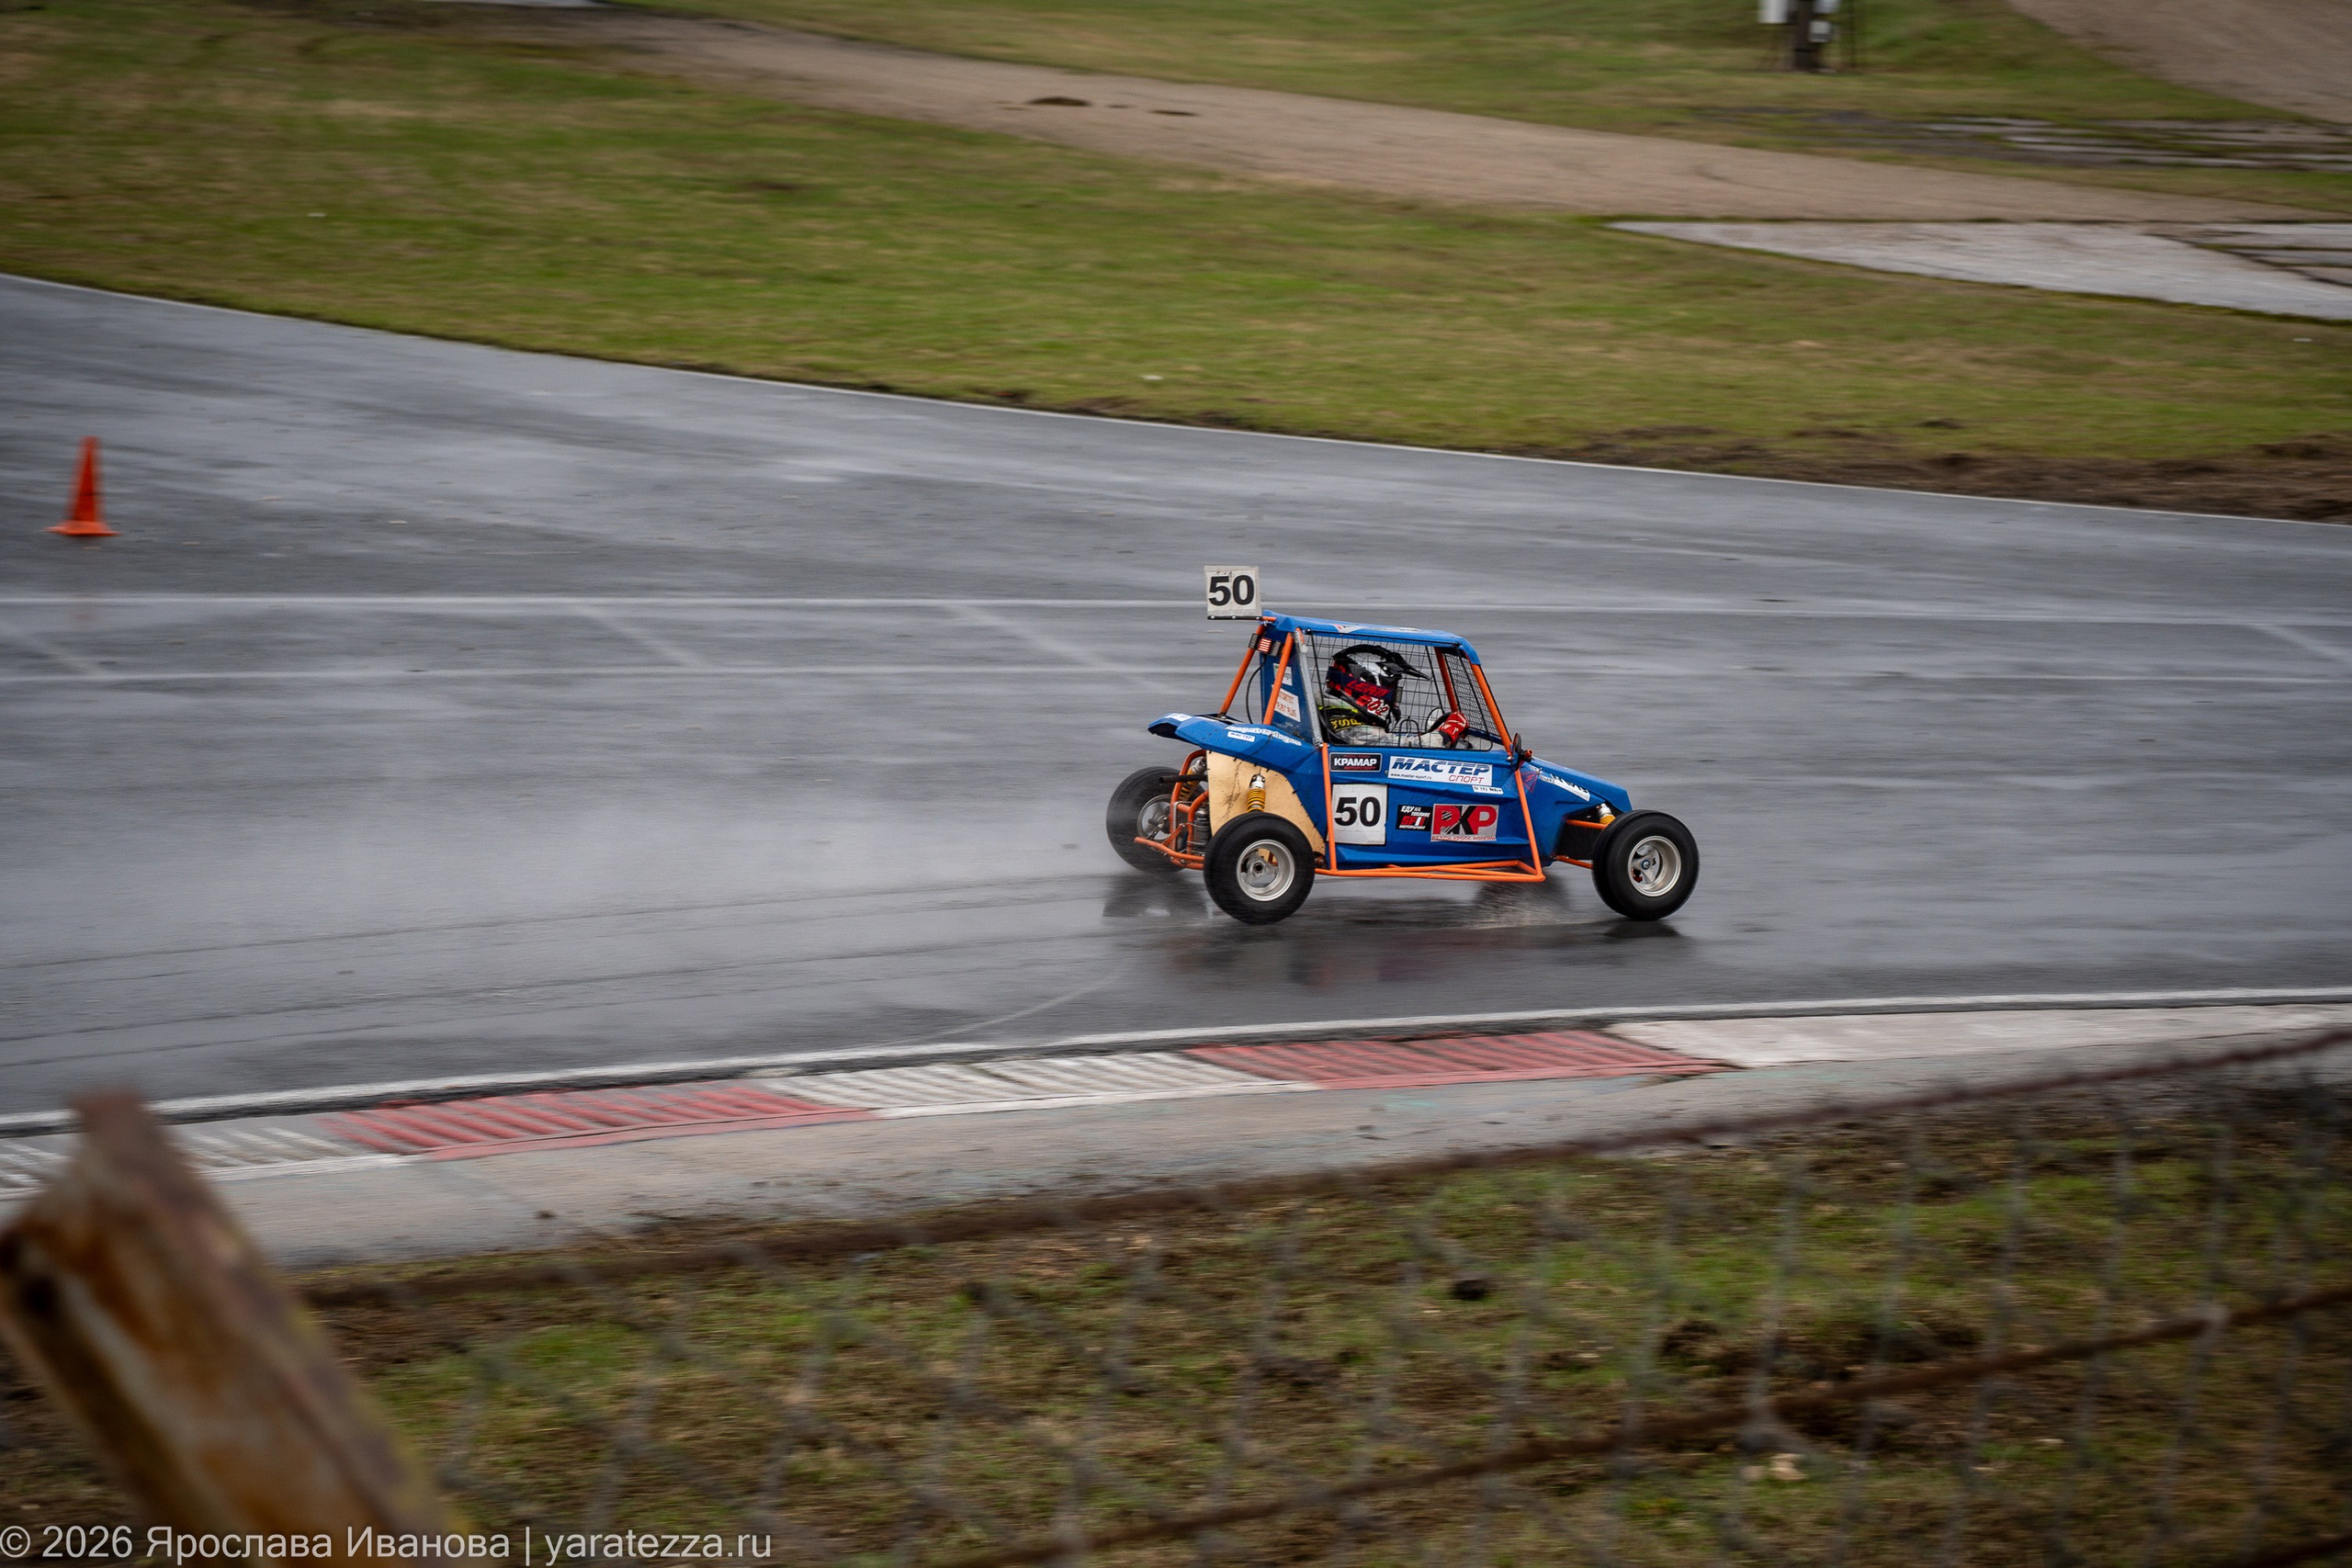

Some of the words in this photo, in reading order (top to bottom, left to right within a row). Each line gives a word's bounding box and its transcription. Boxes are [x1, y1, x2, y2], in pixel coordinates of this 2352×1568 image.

[1208, 574, 1255, 606] 50
[1333, 757, 1377, 767] КРАМАР
[1391, 758, 1490, 776] МАСТЕР
[1448, 774, 1485, 784] СПОРТ
[1334, 796, 1381, 827] 50
